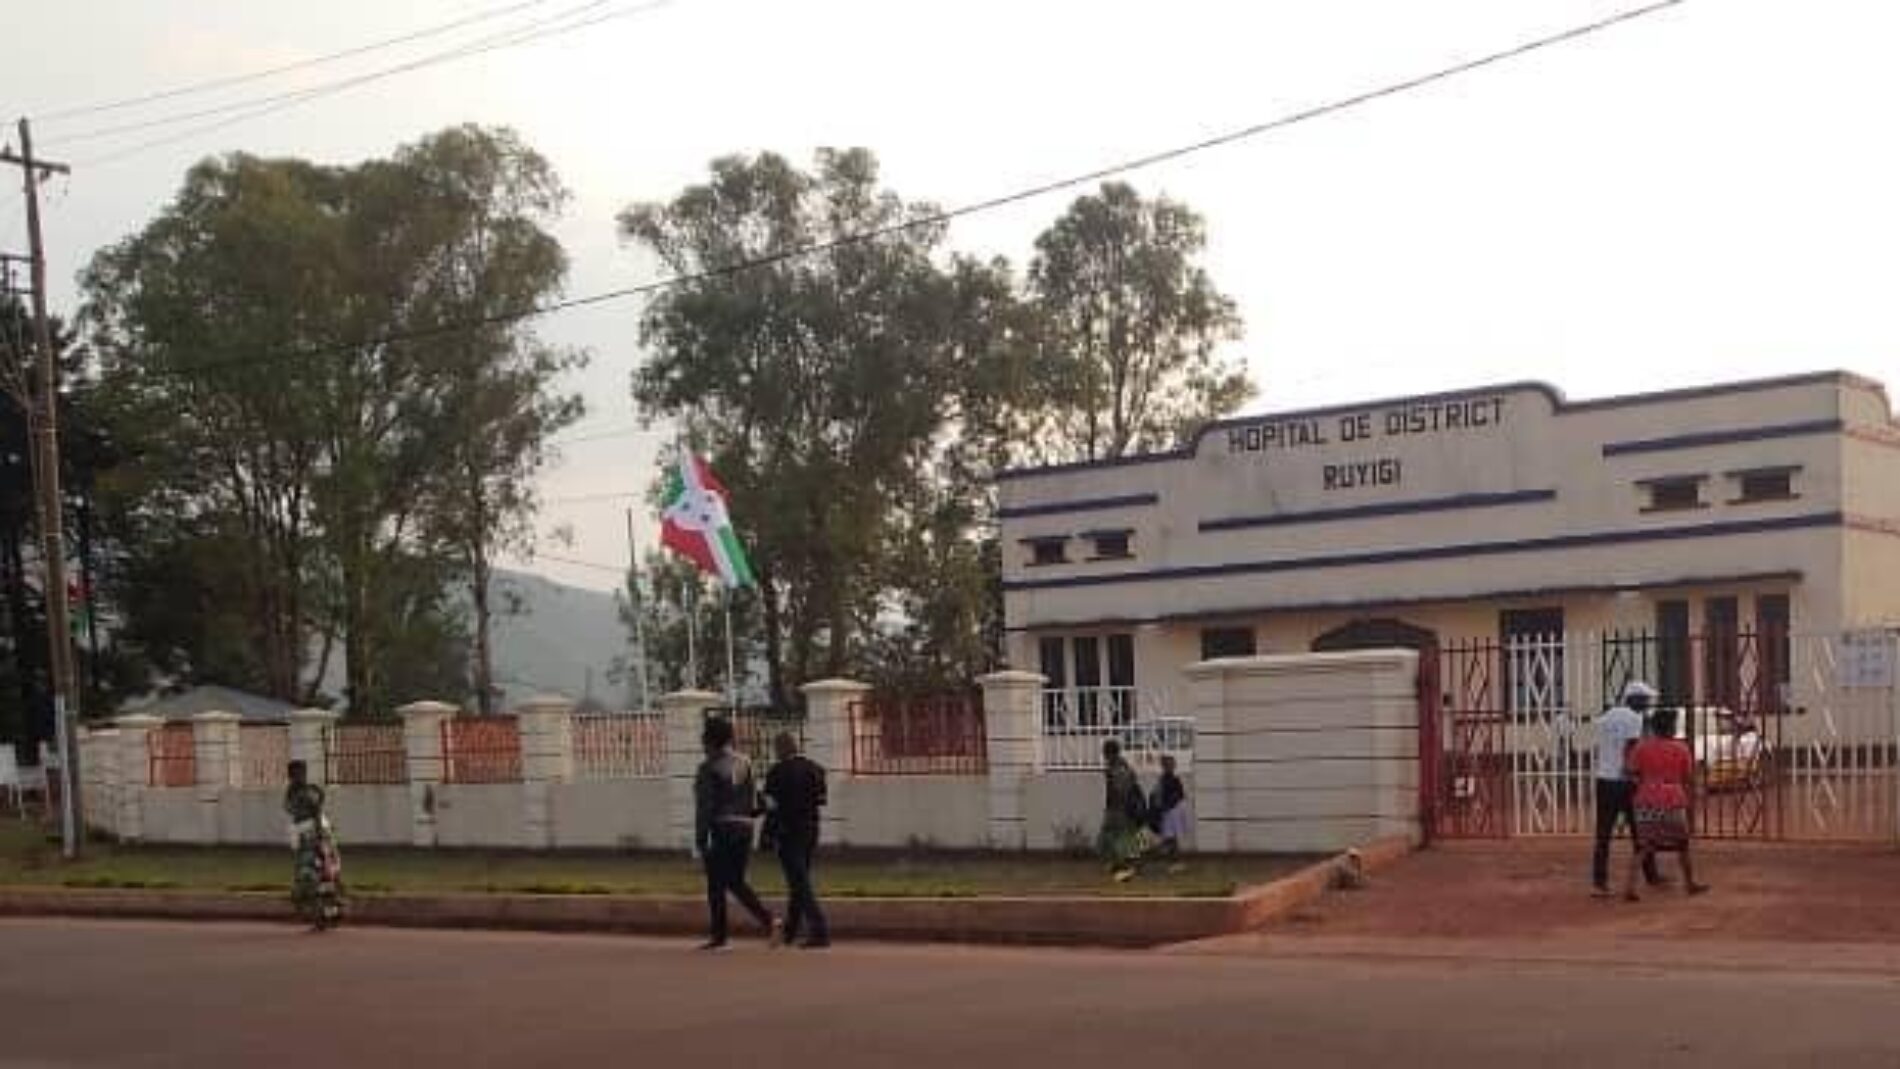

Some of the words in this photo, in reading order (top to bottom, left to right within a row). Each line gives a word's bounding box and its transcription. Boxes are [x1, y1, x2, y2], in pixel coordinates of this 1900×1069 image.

[1229, 422, 1327, 452] HOPITAL
[1341, 414, 1370, 441] DE
[1386, 398, 1503, 435] DISTRICT
[1323, 459, 1402, 490] RUYIGI
